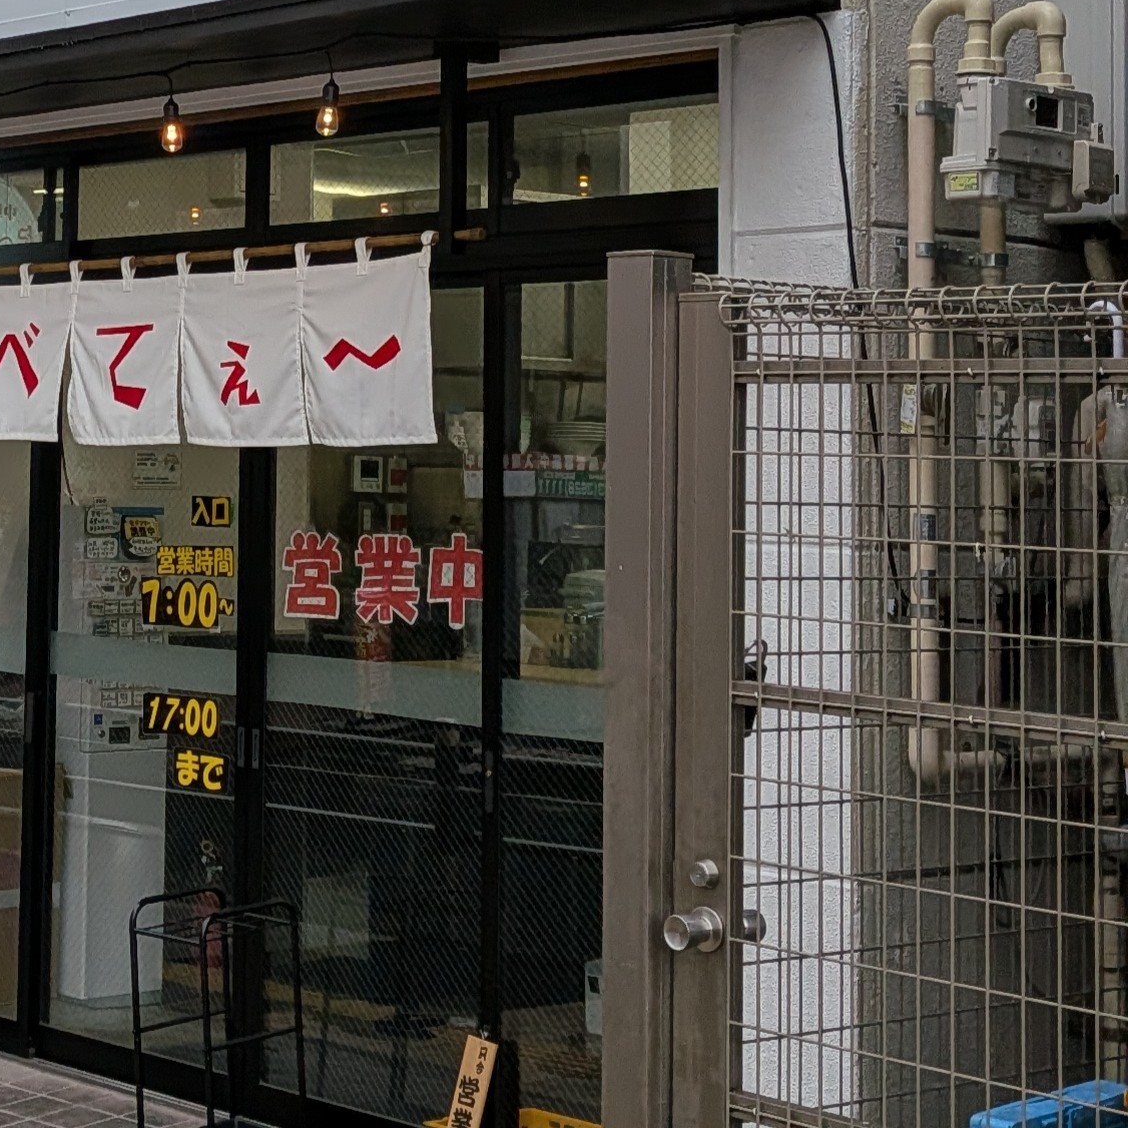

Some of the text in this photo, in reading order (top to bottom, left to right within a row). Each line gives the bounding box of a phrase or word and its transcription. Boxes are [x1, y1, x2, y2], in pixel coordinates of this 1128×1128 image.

[192, 497, 231, 525] 入口
[157, 547, 234, 576] 営業時間
[283, 530, 483, 629] 営業中
[148, 696, 218, 738] 17:00
[176, 751, 224, 791] まで
